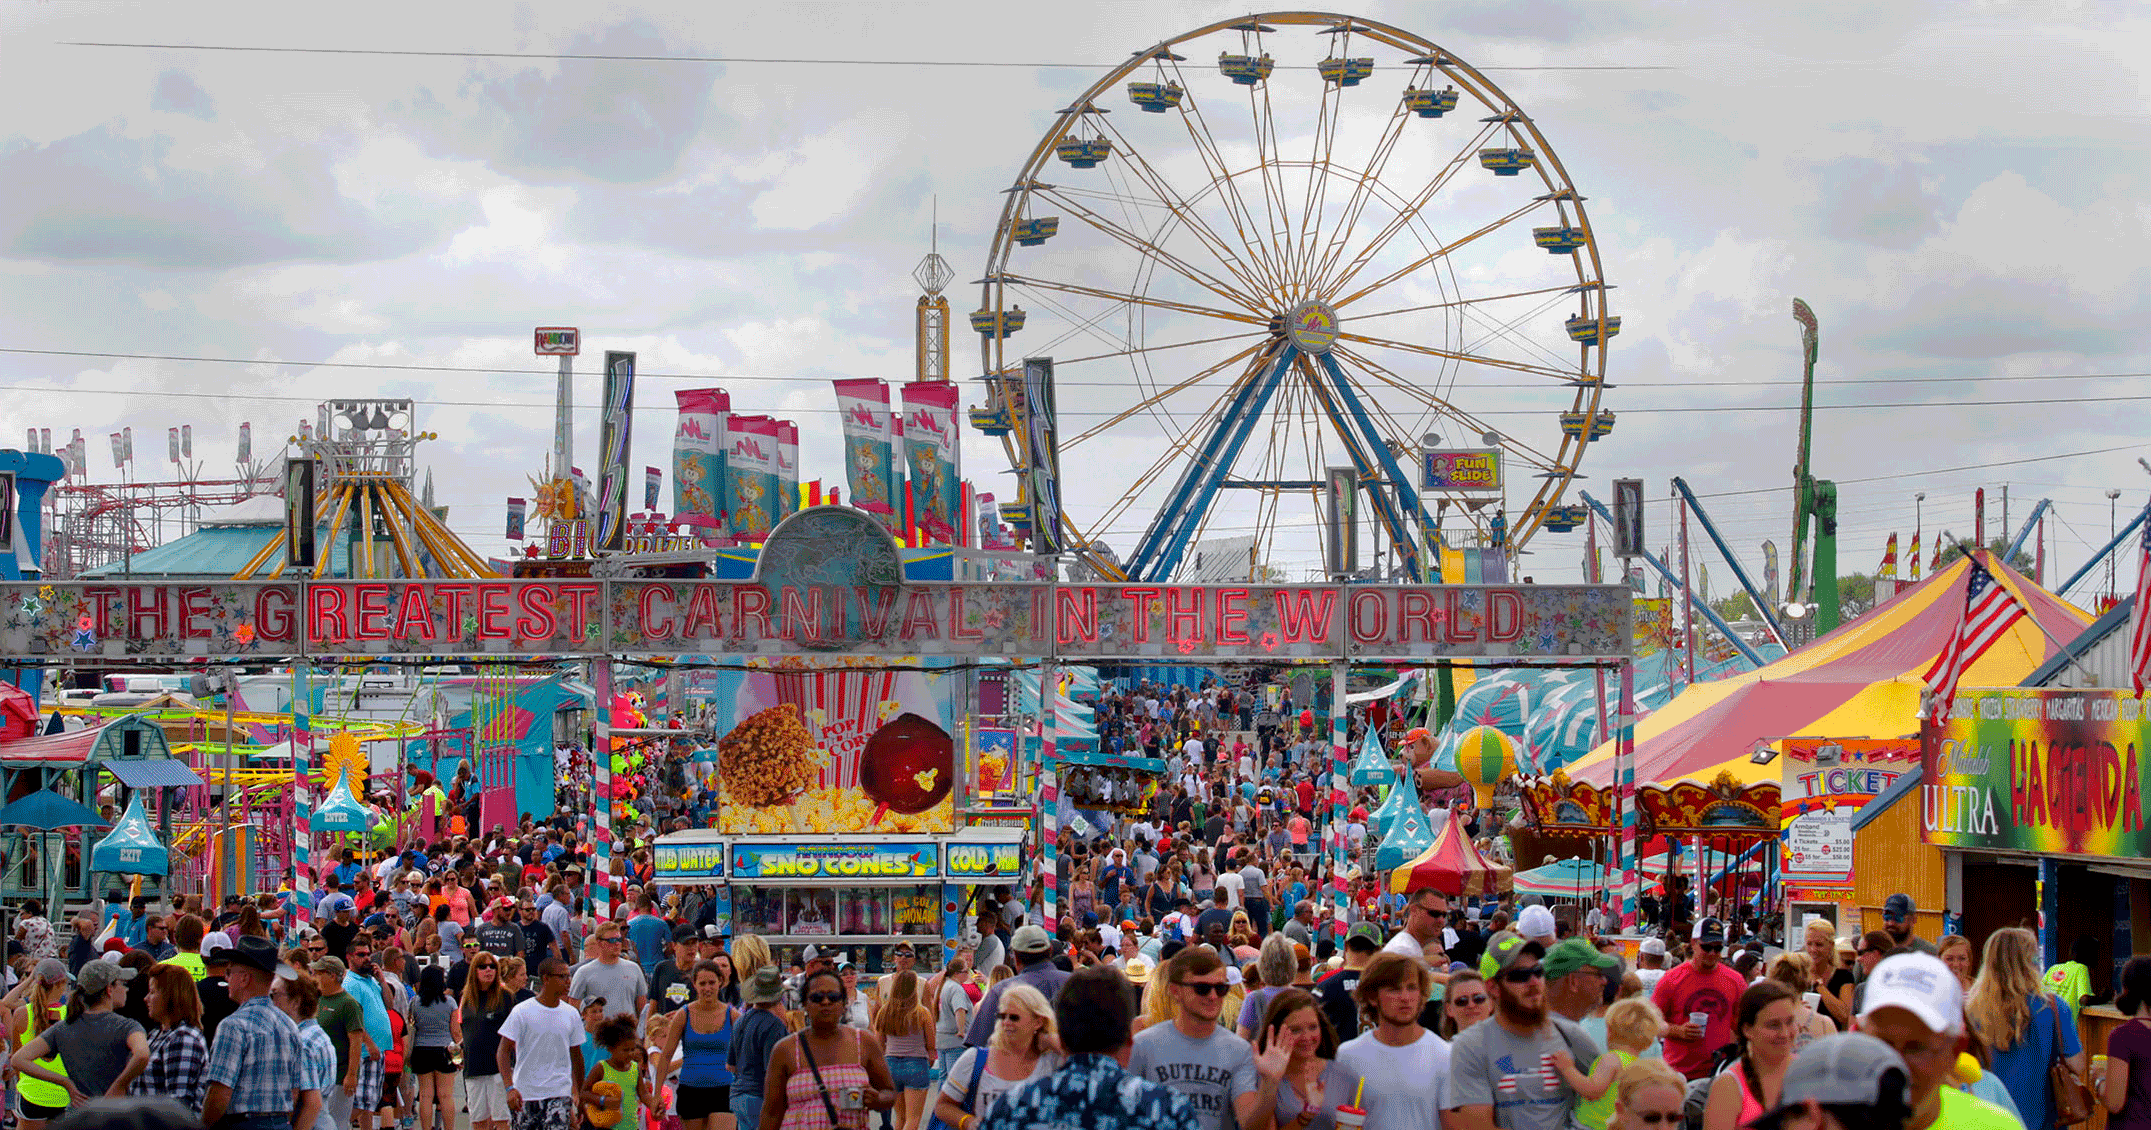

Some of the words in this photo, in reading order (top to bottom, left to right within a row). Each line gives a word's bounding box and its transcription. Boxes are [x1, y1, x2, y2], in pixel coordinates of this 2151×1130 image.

[1455, 458, 1487, 469] FUN
[1449, 469, 1492, 482] SLIDE
[83, 585, 213, 640] THE
[255, 584, 599, 642] GREATEST
[639, 584, 983, 643] CARNIVAL
[1031, 586, 1098, 643] IN
[1121, 587, 1249, 645] THE
[1275, 588, 1525, 645] WORLD
[2046, 697, 2084, 720] MARGARITAS
[822, 719, 855, 738] POP
[829, 733, 873, 757] COR
[1937, 738, 1992, 778] Michelob
[1797, 767, 1905, 797] TICKET
[2009, 739, 2145, 834] HACIENDA
[324, 812, 348, 822] ENTER
[1923, 784, 1998, 834] ULTRA
[120, 849, 142, 862] EXIT
[679, 847, 721, 870] WATER
[796, 846, 875, 858] RAINBOW
[950, 846, 988, 872] COLD
[761, 854, 820, 876] SNO
[823, 853, 911, 876] CONES
[1343, 979, 1359, 990] BR
[1155, 1063, 1233, 1088] BUTLER
[1188, 1092, 1222, 1112] ARS
